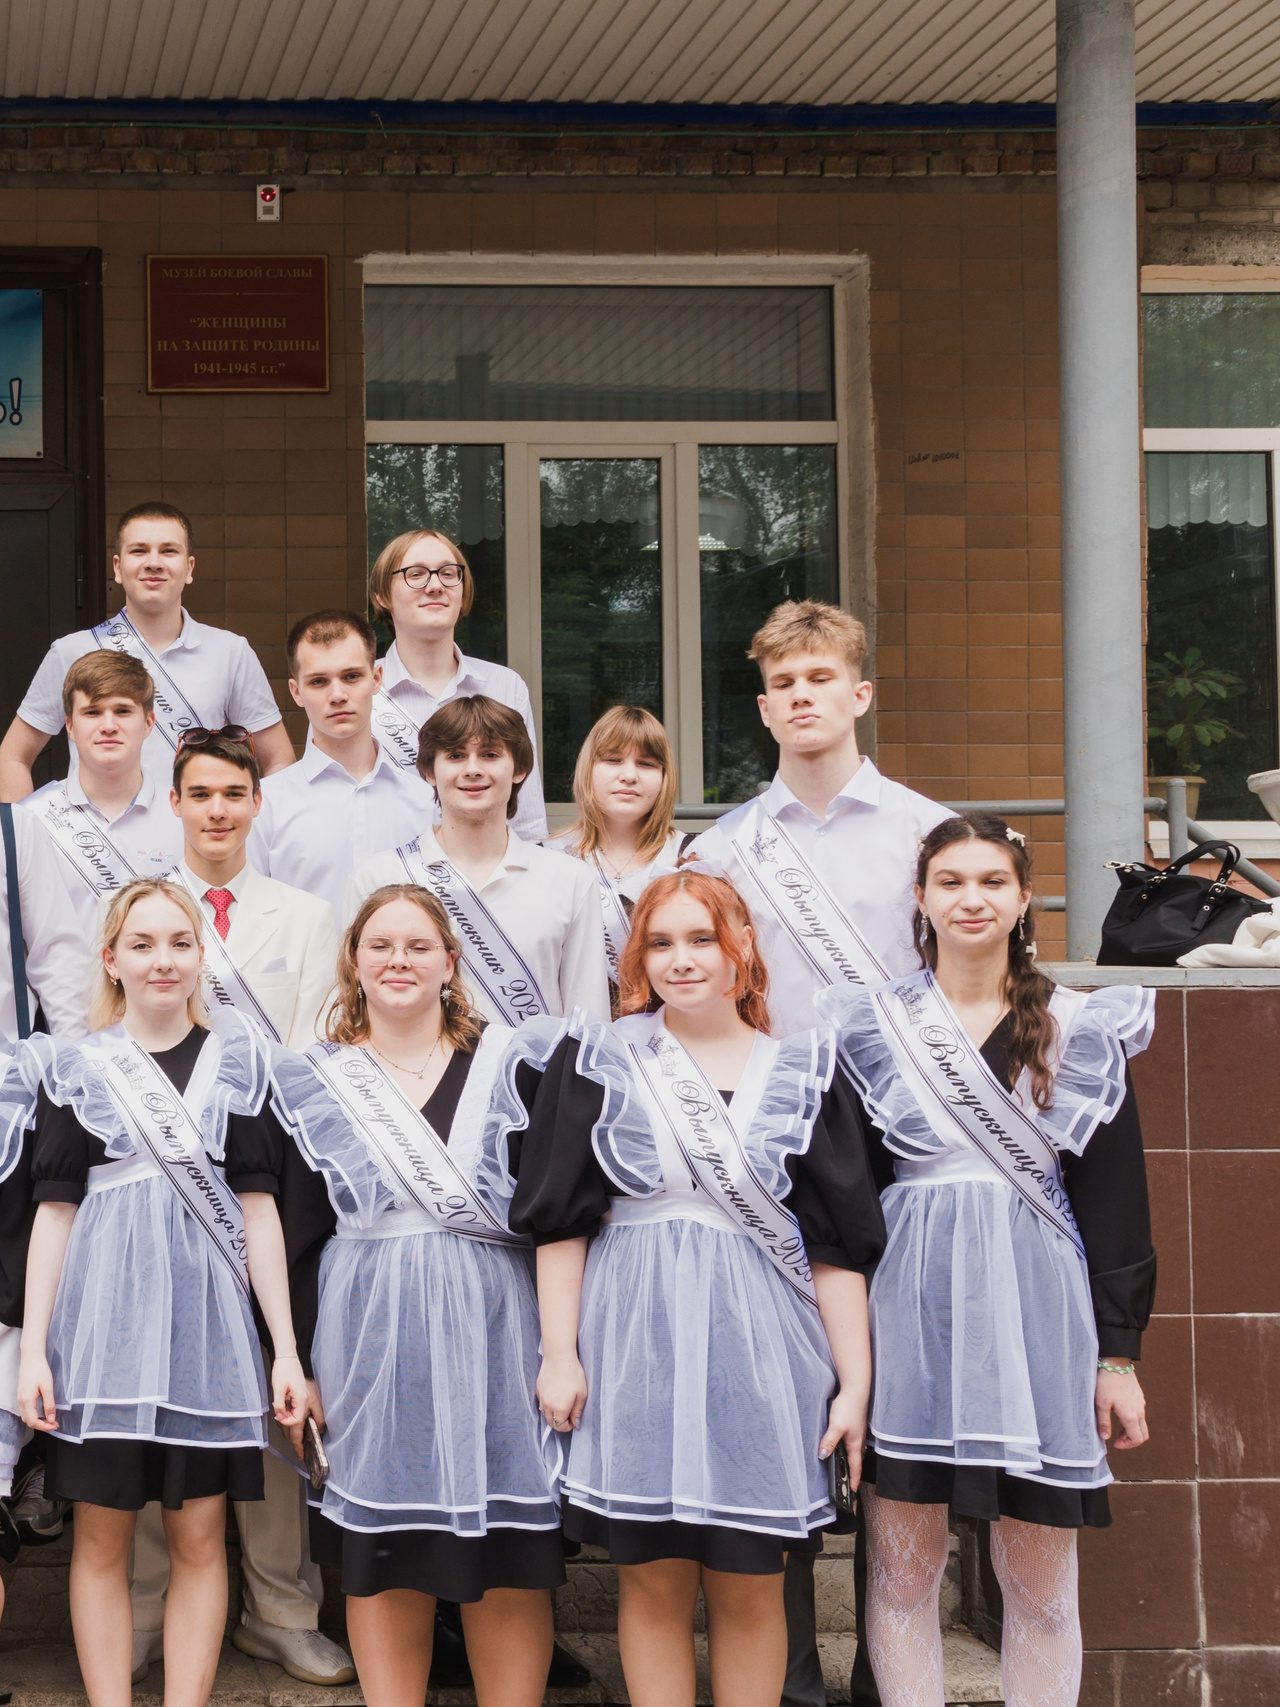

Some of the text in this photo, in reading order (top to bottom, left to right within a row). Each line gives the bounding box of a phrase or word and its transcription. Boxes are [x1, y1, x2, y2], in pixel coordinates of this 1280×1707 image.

[162, 267, 313, 278] МУЗЕЙ БОЕВОЙ СЛАВЫ
[157, 340, 320, 352] НА ЗАЩИТЕ РОДИНЫ
[193, 362, 257, 374] 1941-1945
[775, 867, 866, 985] Выпускни
[498, 979, 540, 1021] 202
[141, 1092, 234, 1233] Выпускница
[339, 1060, 445, 1195] Выпускница
[672, 1079, 778, 1241] Выпускница
[919, 1025, 1045, 1183] Выпускница
